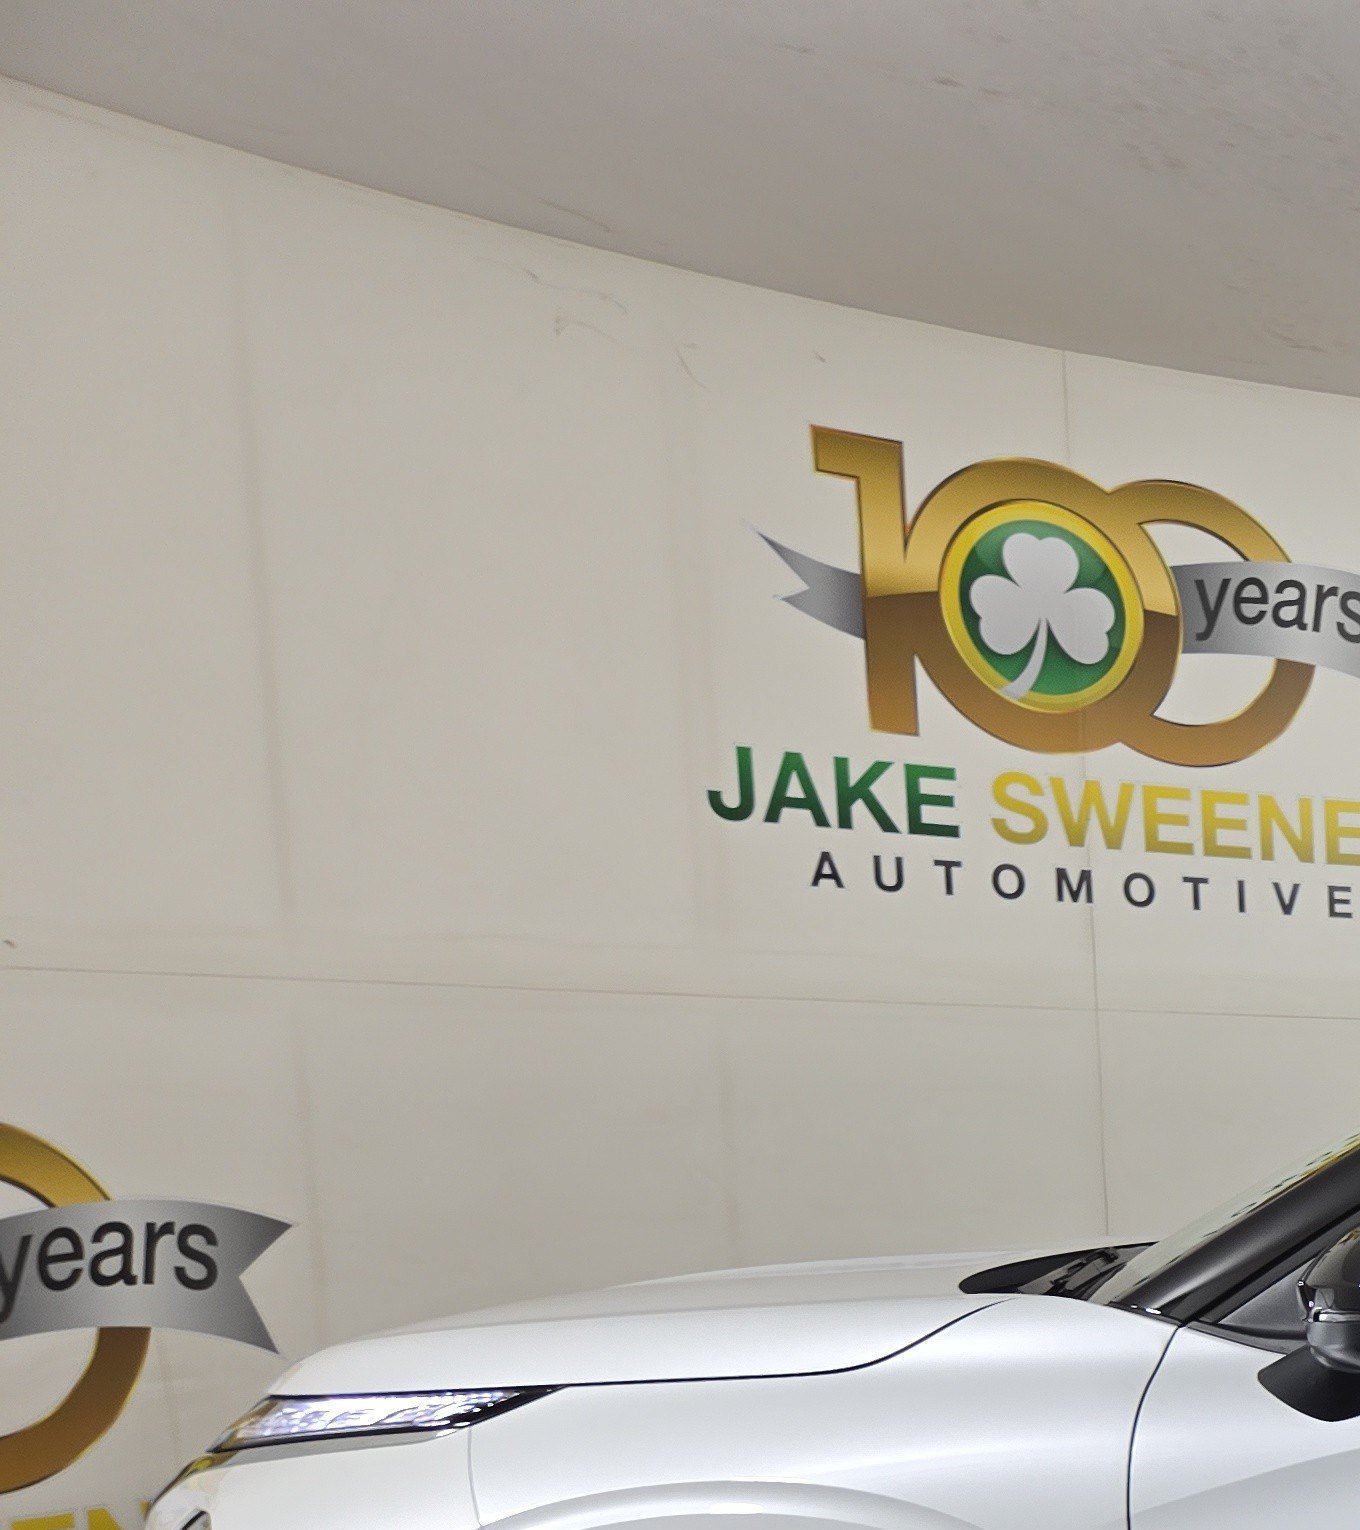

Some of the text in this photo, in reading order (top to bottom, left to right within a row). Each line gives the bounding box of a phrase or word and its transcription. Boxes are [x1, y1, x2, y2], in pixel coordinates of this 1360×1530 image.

[808, 423, 1317, 769] 100
[708, 742, 960, 838] JAKE
[812, 851, 1353, 919] AUTOMOTIVE
[0, 1220, 219, 1325] years
